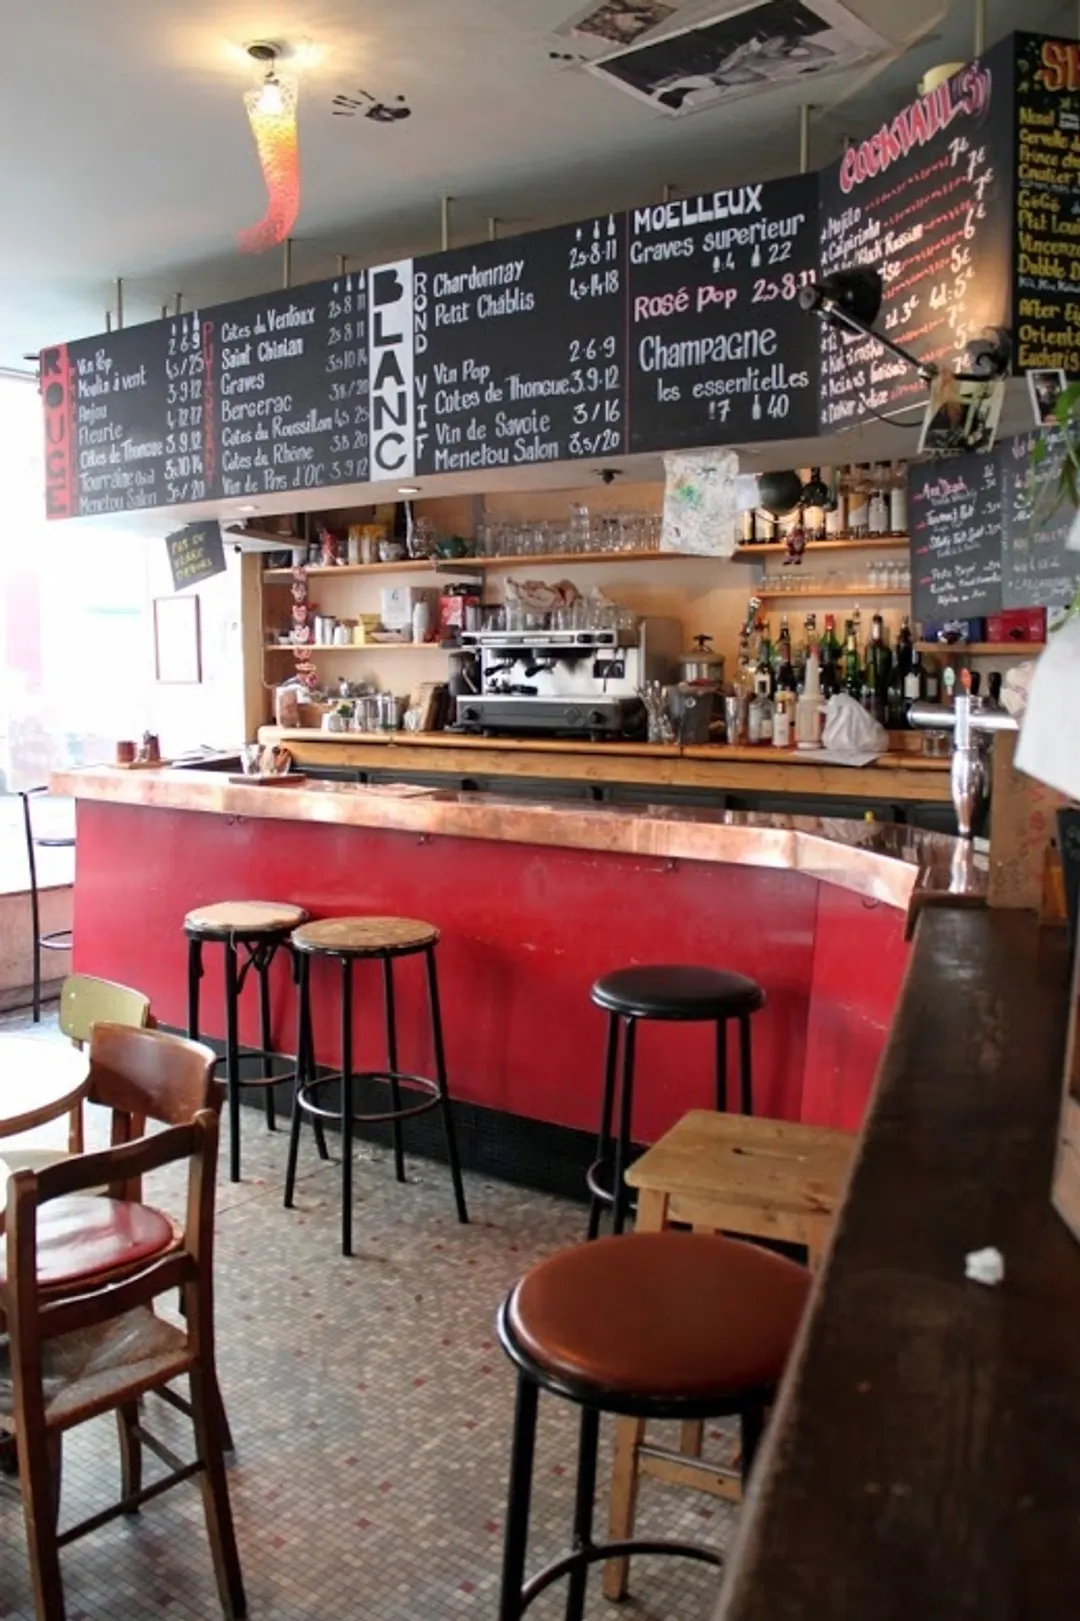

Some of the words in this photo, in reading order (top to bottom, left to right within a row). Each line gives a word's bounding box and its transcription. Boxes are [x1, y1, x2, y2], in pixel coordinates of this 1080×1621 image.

[634, 184, 764, 236] MOELLEUX
[630, 237, 694, 265] Graves
[703, 213, 806, 253] superieur
[767, 241, 793, 265] 22
[433, 260, 525, 298] Chardonnay
[414, 272, 428, 354] ROND
[435, 302, 471, 328] Petit
[477, 286, 536, 319] Chablis
[634, 287, 690, 323] Rosé
[221, 342, 251, 370] Saint
[639, 328, 778, 373] Champagne
[220, 372, 266, 395] Graves
[373, 269, 408, 471] BLANC
[433, 362, 458, 385] Vin
[462, 358, 491, 385] Pop
[657, 378, 682, 402] les
[692, 363, 810, 399] essentielles
[435, 388, 480, 415] Cotes
[485, 380, 504, 404] de
[767, 394, 790, 418] 40
[414, 375, 428, 460] VIF
[435, 421, 461, 445] Vin
[466, 417, 487, 441] de
[495, 407, 551, 439] Savoie
[434, 443, 510, 471] Menetou
[513, 435, 560, 462] Salon
